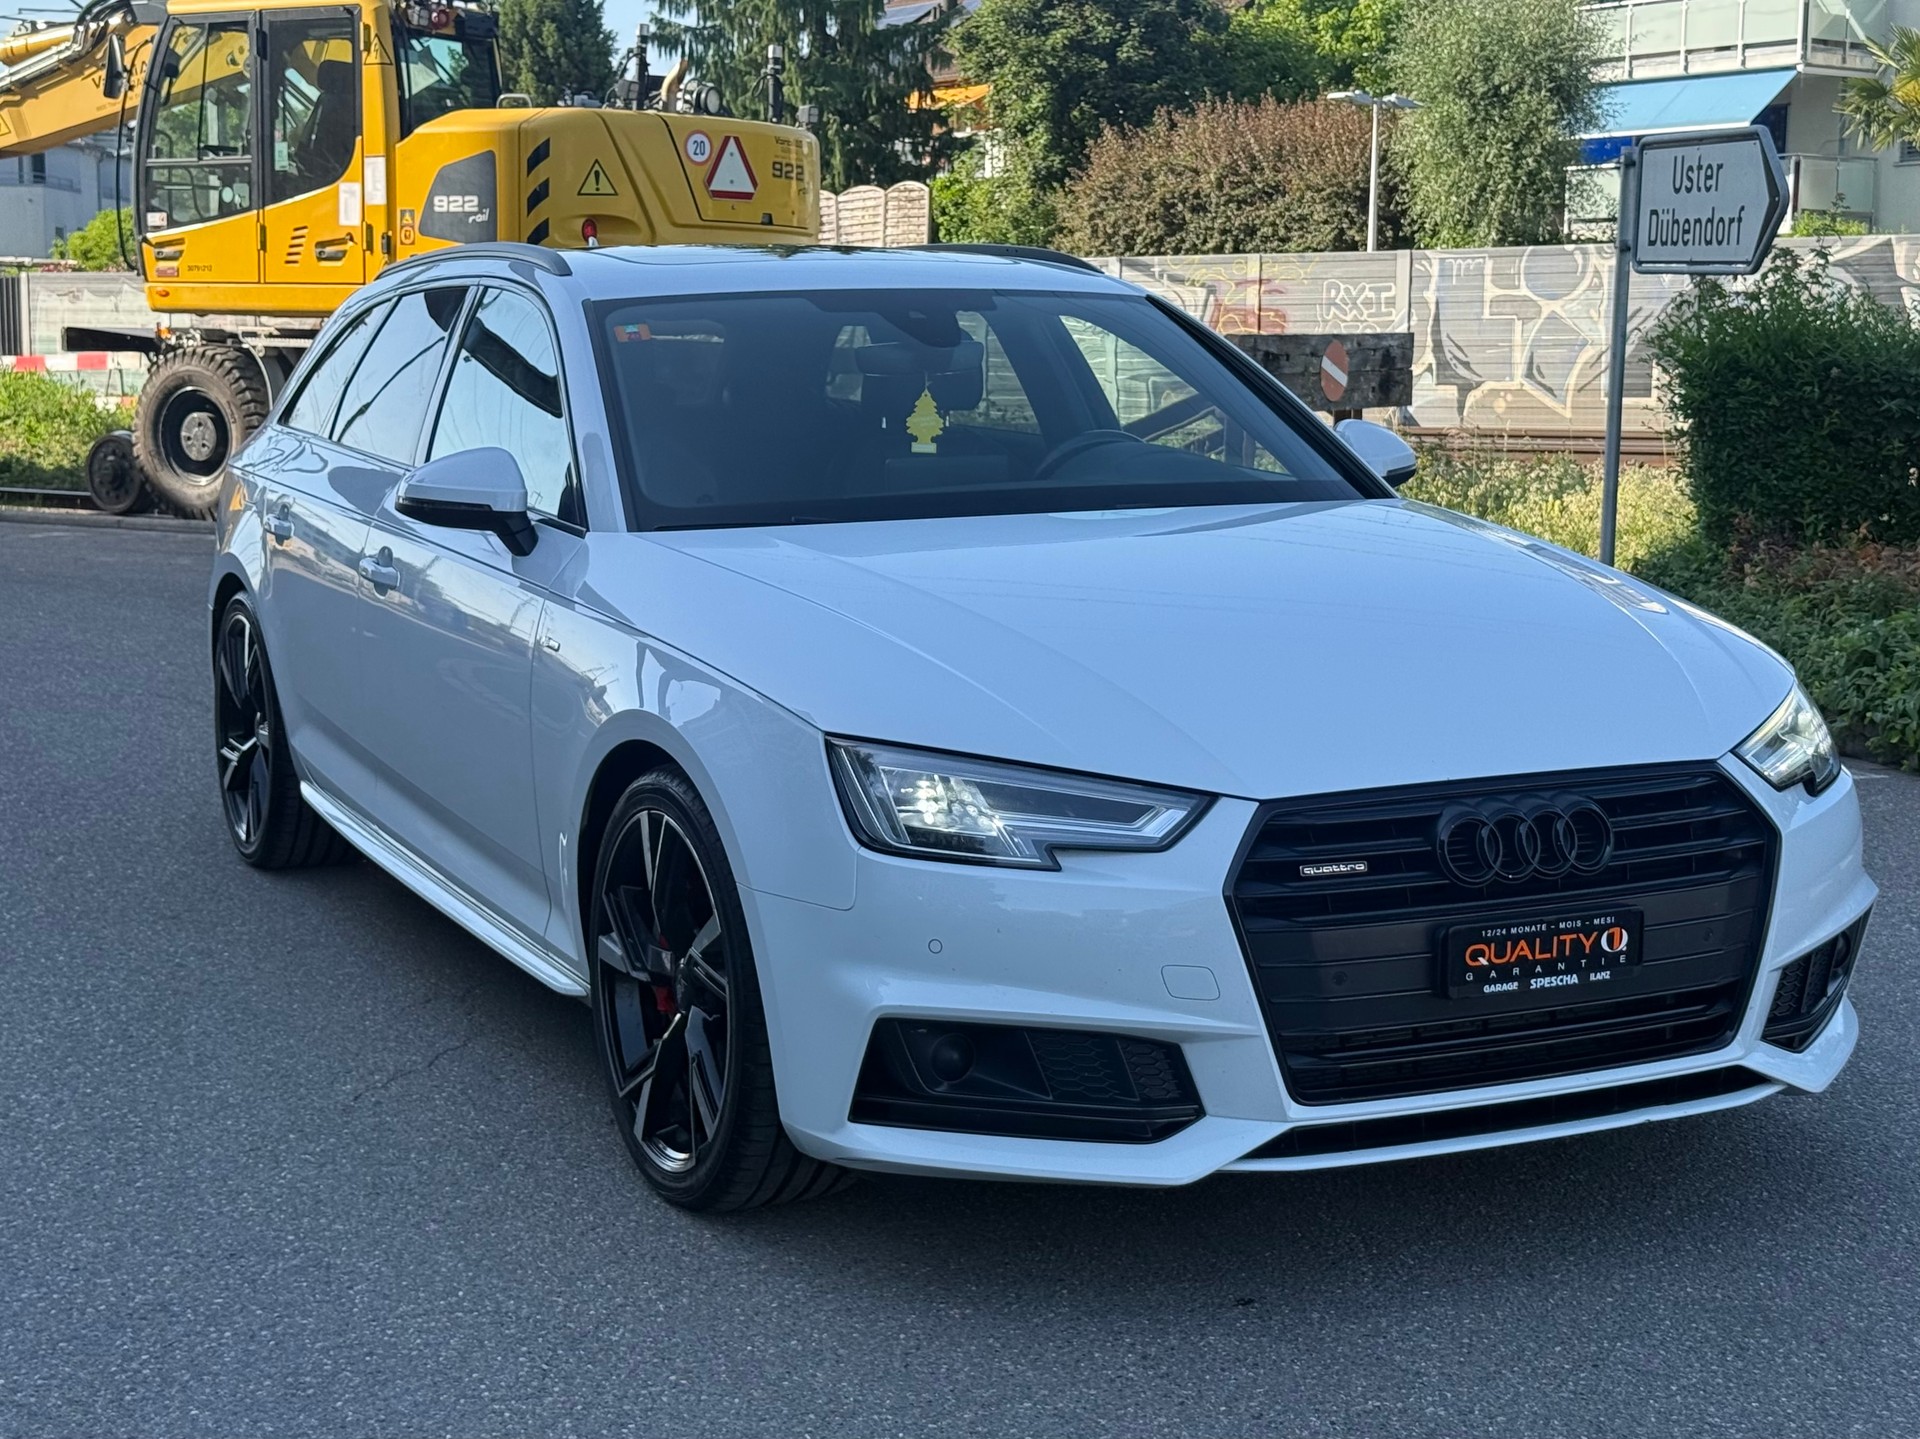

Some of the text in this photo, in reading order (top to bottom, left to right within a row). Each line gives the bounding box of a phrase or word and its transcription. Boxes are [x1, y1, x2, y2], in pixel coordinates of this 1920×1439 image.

[692, 139, 706, 156] 20
[772, 161, 804, 181] 922
[1672, 154, 1724, 194] Uster
[433, 195, 479, 213] 922
[468, 207, 490, 224] rail
[1647, 204, 1745, 247] Dübendorf
[1303, 863, 1365, 875] quattro
[1481, 928, 1507, 938] 12/24
[1510, 923, 1547, 934] MONATE
[1559, 919, 1582, 929] MOIS
[1593, 916, 1615, 925] MESI
[1465, 931, 1599, 967] QUALITY
[1465, 954, 1626, 982] GARANTIE
[1483, 970, 1611, 993] GARAGE SPESCHA ILANZ
